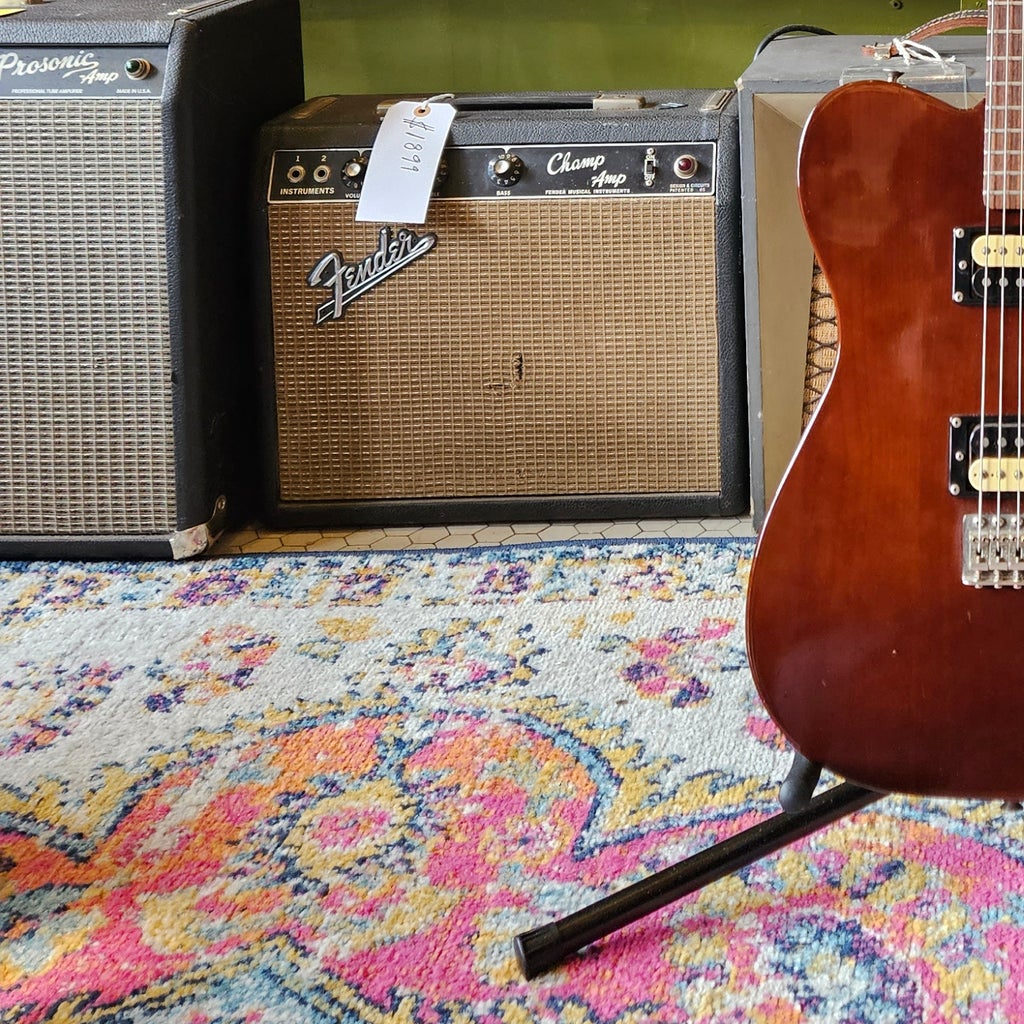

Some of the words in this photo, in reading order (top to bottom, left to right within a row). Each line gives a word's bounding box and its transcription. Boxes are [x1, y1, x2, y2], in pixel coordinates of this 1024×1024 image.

[0, 50, 100, 79] Prosonic
[79, 68, 120, 85] Amp
[401, 117, 436, 173] $1899
[547, 151, 605, 176] Champ
[280, 187, 335, 196] INSTRUMENTS
[590, 170, 627, 188] Amp
[307, 226, 437, 324] Fender
